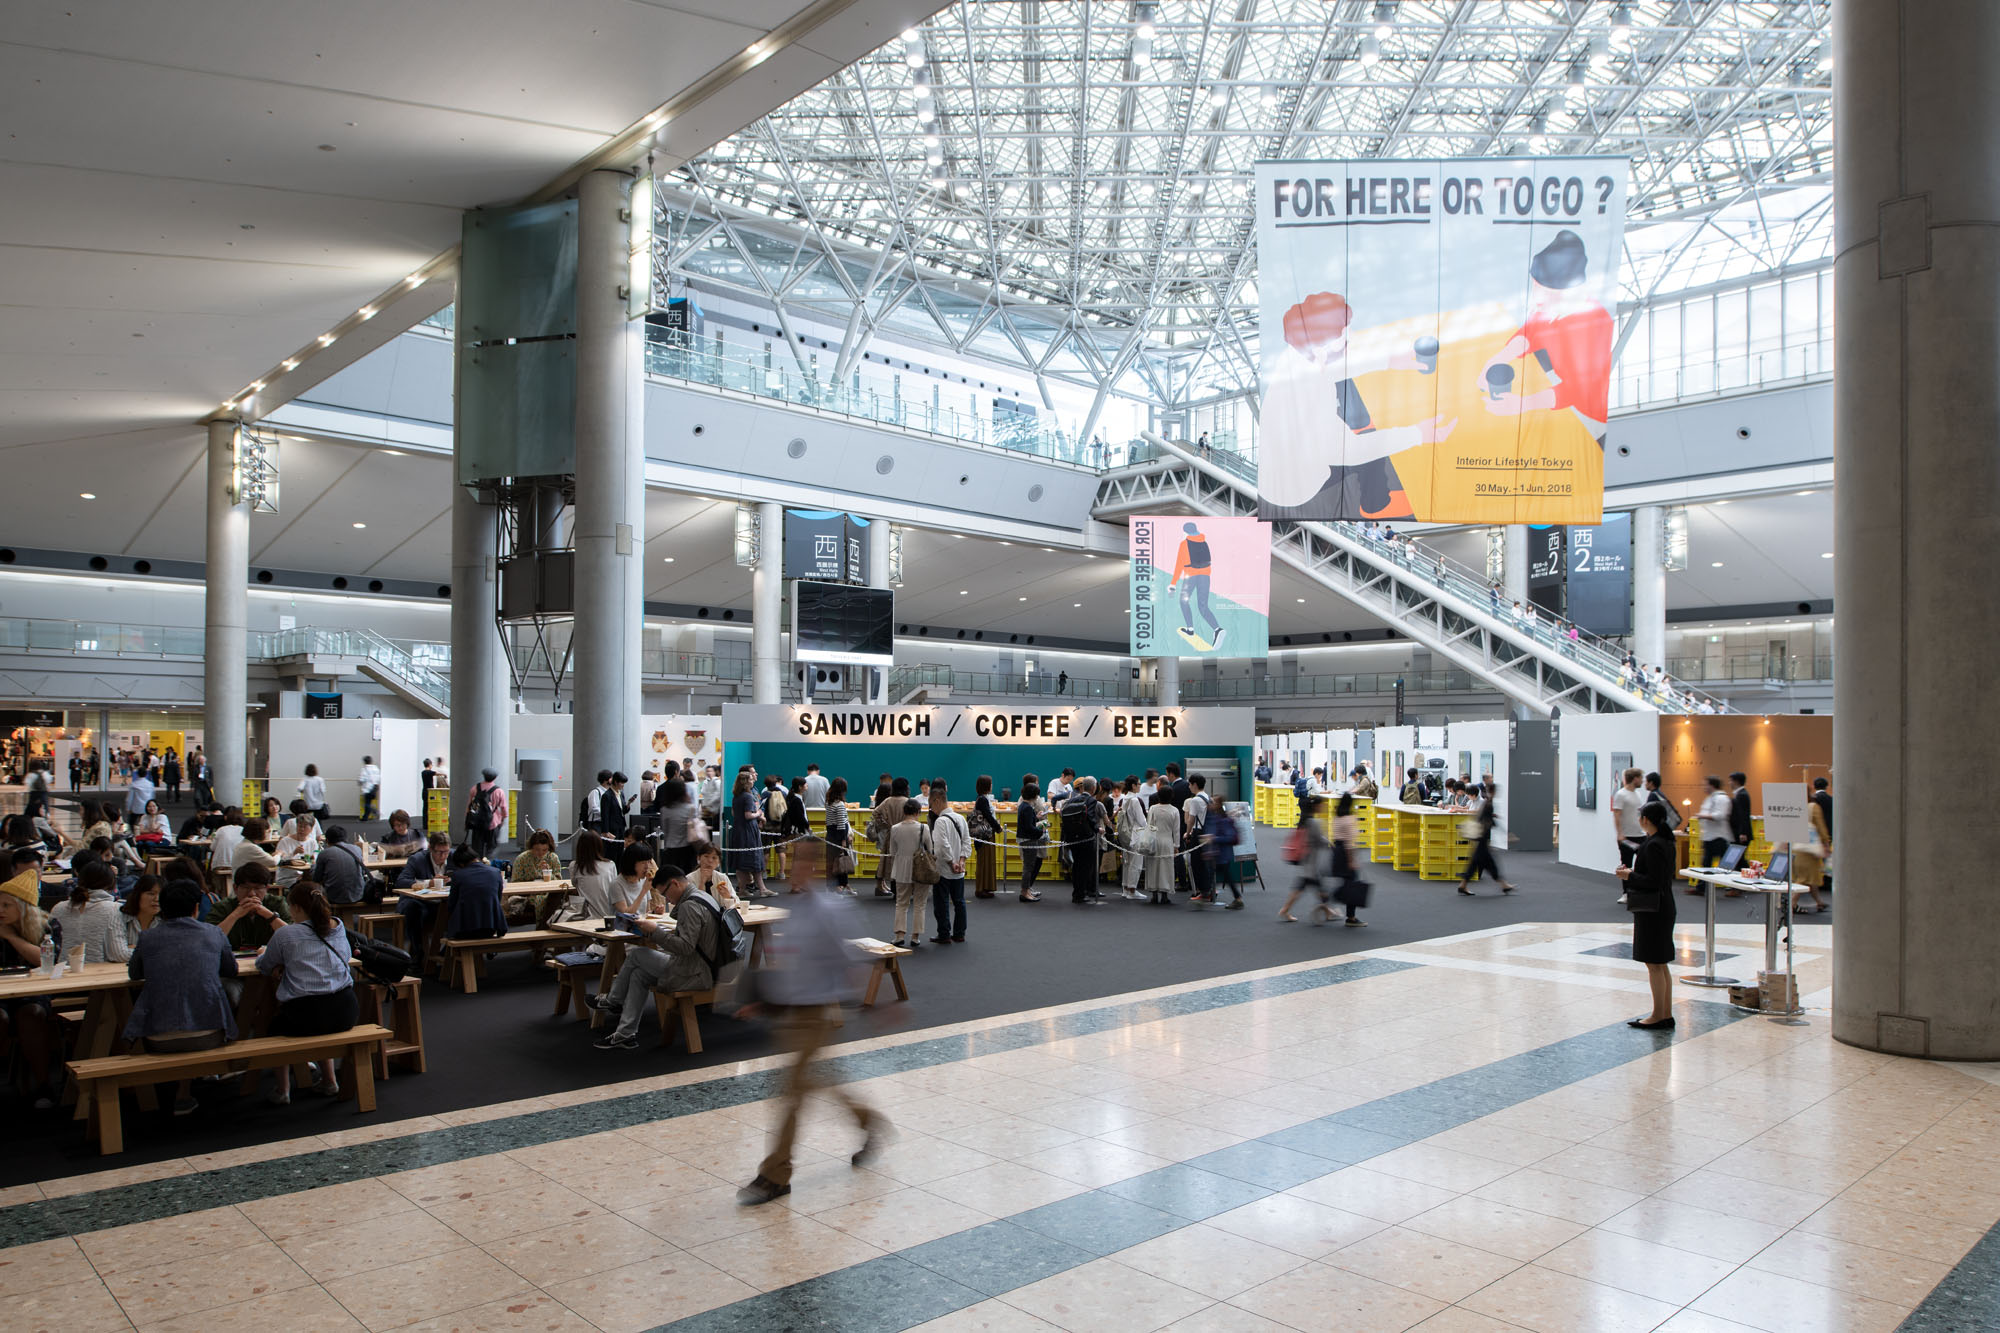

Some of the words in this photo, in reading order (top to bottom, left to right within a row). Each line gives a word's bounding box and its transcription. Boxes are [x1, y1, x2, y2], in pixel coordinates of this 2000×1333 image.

[1274, 178, 1336, 218] FOR
[1346, 177, 1431, 216] HERE
[1442, 177, 1484, 215] OR
[1494, 176, 1534, 216] TO
[1541, 176, 1584, 216] GO
[1594, 175, 1615, 215] ?
[668, 310, 682, 325] 西
[667, 326, 682, 346] 4
[1456, 456, 1492, 466] Interior
[1495, 457, 1538, 468] Lifestyle
[1541, 457, 1573, 469] Tokyo
[1475, 483, 1487, 493] 30
[1488, 484, 1511, 494] May.
[1520, 484, 1525, 492] 1
[1526, 484, 1546, 493] Jun.
[1547, 484, 1572, 493] 2018
[814, 534, 838, 560] 西
[1548, 531, 1560, 551] 西
[1574, 528, 1593, 548] 西
[849, 537, 860, 564] 西
[1574, 548, 1591, 573] 2
[1548, 551, 1558, 575] 2
[324, 703, 338, 719] 西
[798, 712, 931, 737] SANDWICH
[947, 714, 962, 737] /
[975, 714, 1070, 738] COFFEE
[1084, 714, 1099, 738] /
[1114, 715, 1178, 738] BEER
